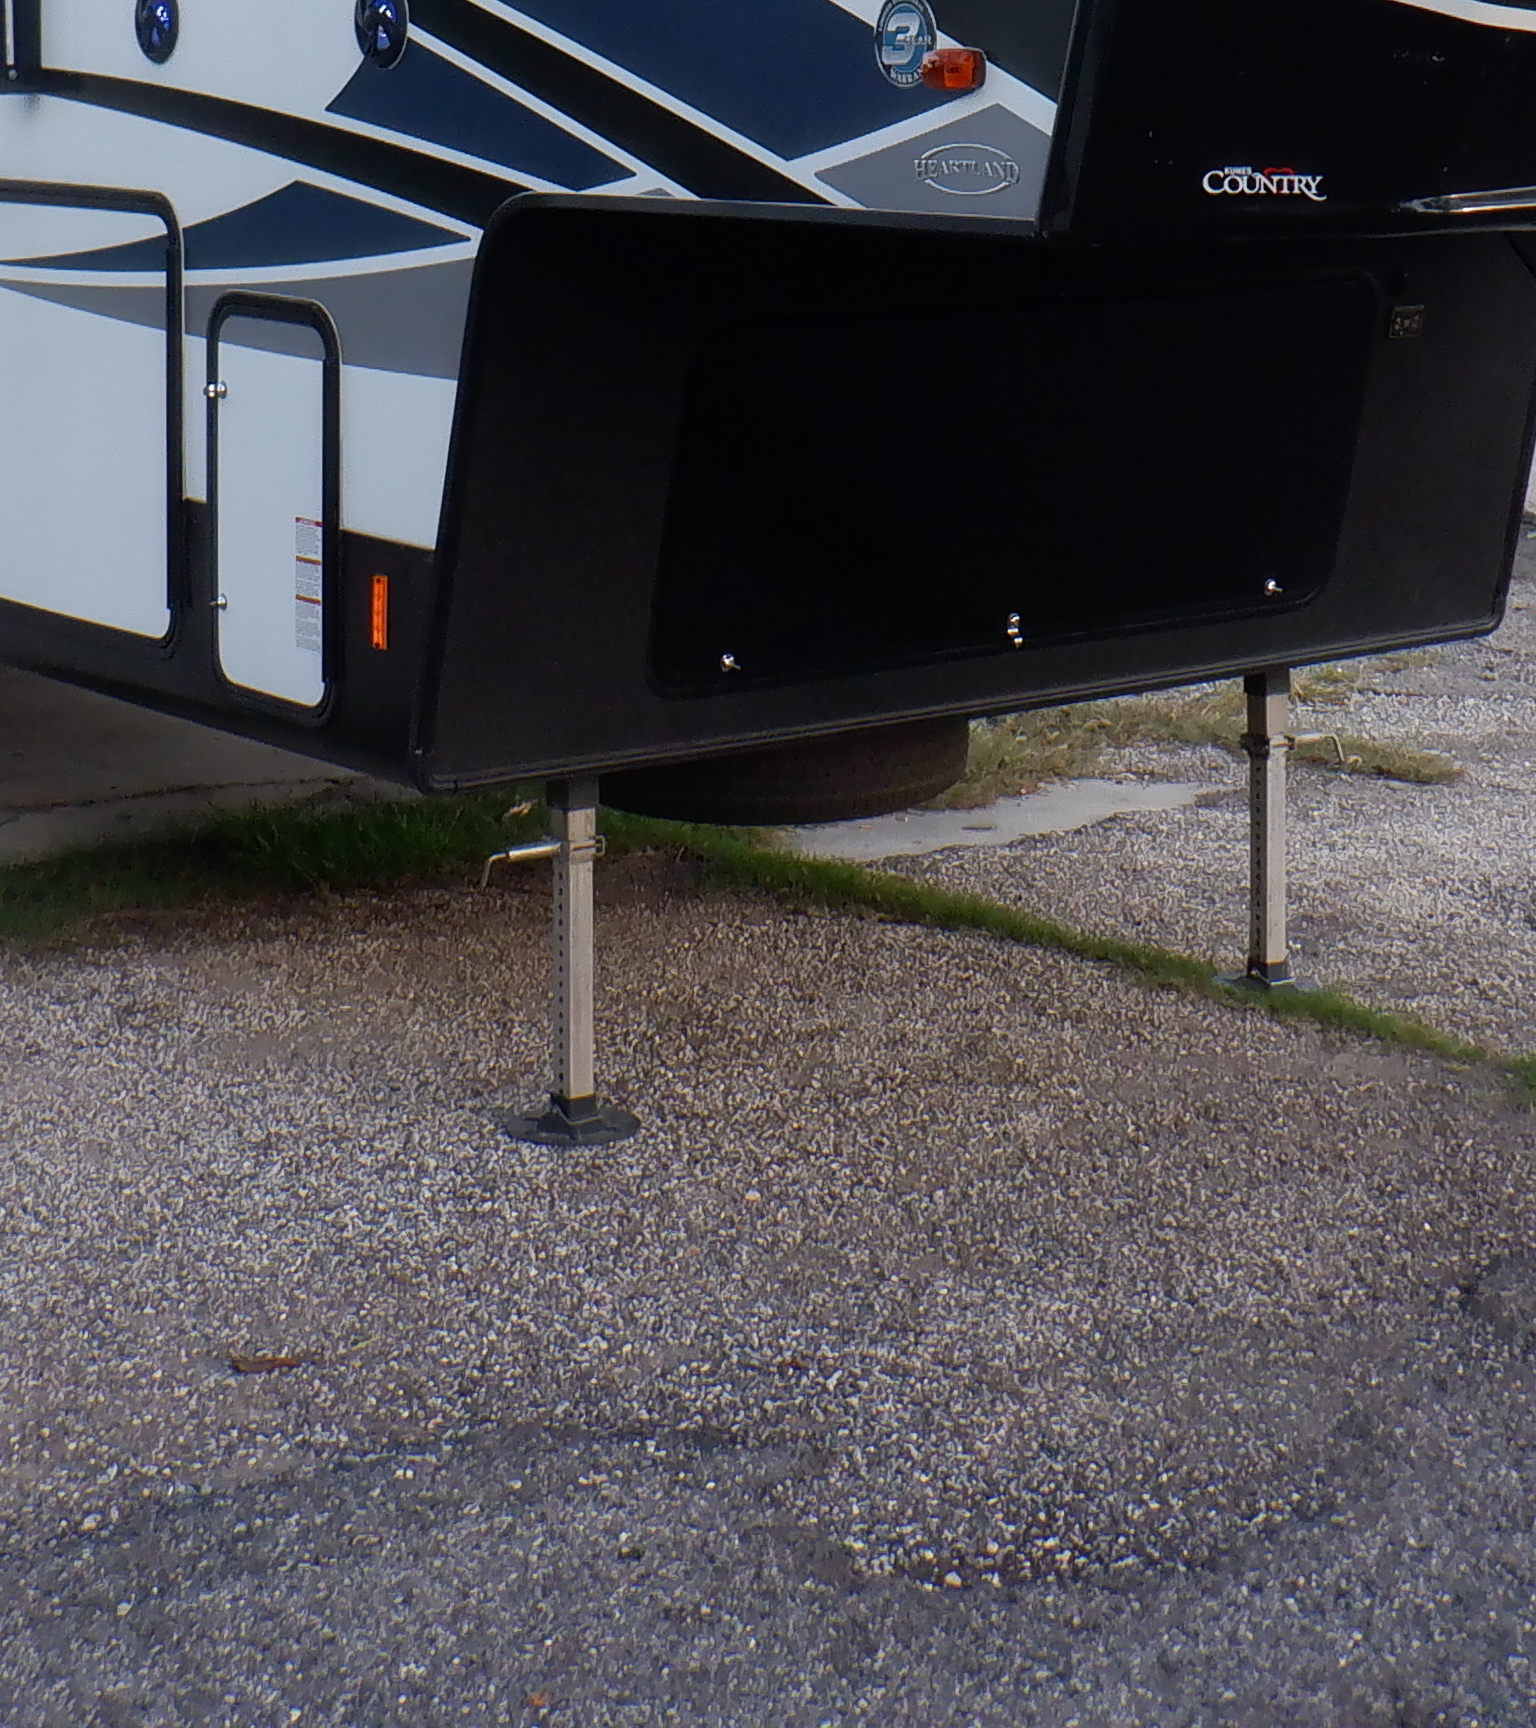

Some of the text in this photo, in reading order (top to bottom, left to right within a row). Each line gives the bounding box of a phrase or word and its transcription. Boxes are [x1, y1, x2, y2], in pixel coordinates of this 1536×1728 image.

[881, 12, 922, 65] 3
[913, 159, 1020, 183] HEARTLAND
[1202, 170, 1327, 201] COUNTRY
